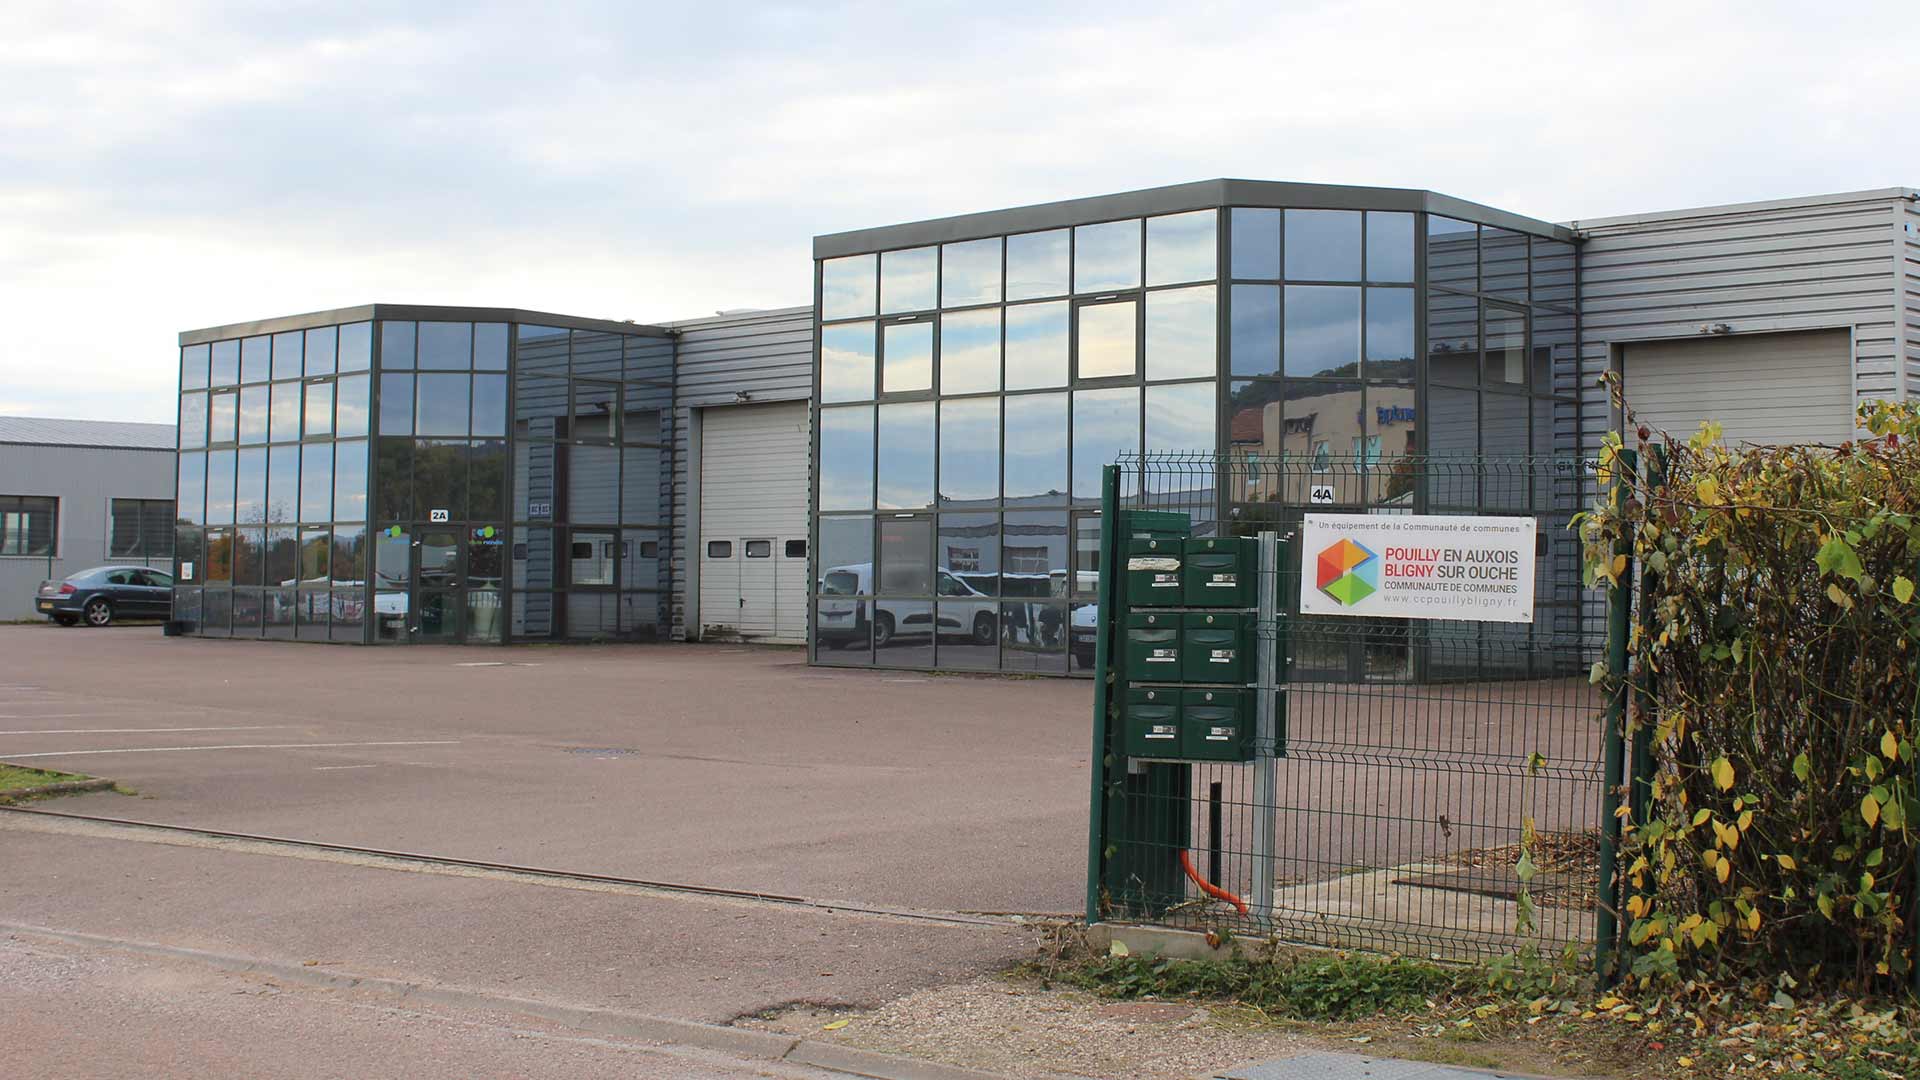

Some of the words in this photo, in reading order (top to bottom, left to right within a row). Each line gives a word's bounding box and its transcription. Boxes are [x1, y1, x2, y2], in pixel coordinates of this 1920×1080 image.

[1312, 488, 1332, 500] 4A
[433, 511, 446, 520] 2A
[1331, 522, 1378, 532] équipement
[1403, 523, 1458, 531] Communauté
[1460, 524, 1471, 532] de
[1385, 547, 1440, 561] POUILLY
[1443, 549, 1463, 562] EN
[1465, 550, 1519, 564] AUXOIS
[1385, 563, 1434, 577] BLIGNY
[1437, 565, 1465, 578] SUR
[1468, 566, 1518, 580] OUCHE
[1384, 581, 1449, 591] COMMUNAUTE
[1450, 583, 1461, 592] DE
[1463, 584, 1518, 593] COMMUNES
[1383, 594, 1517, 607] www.ccpouillybligny.fr
